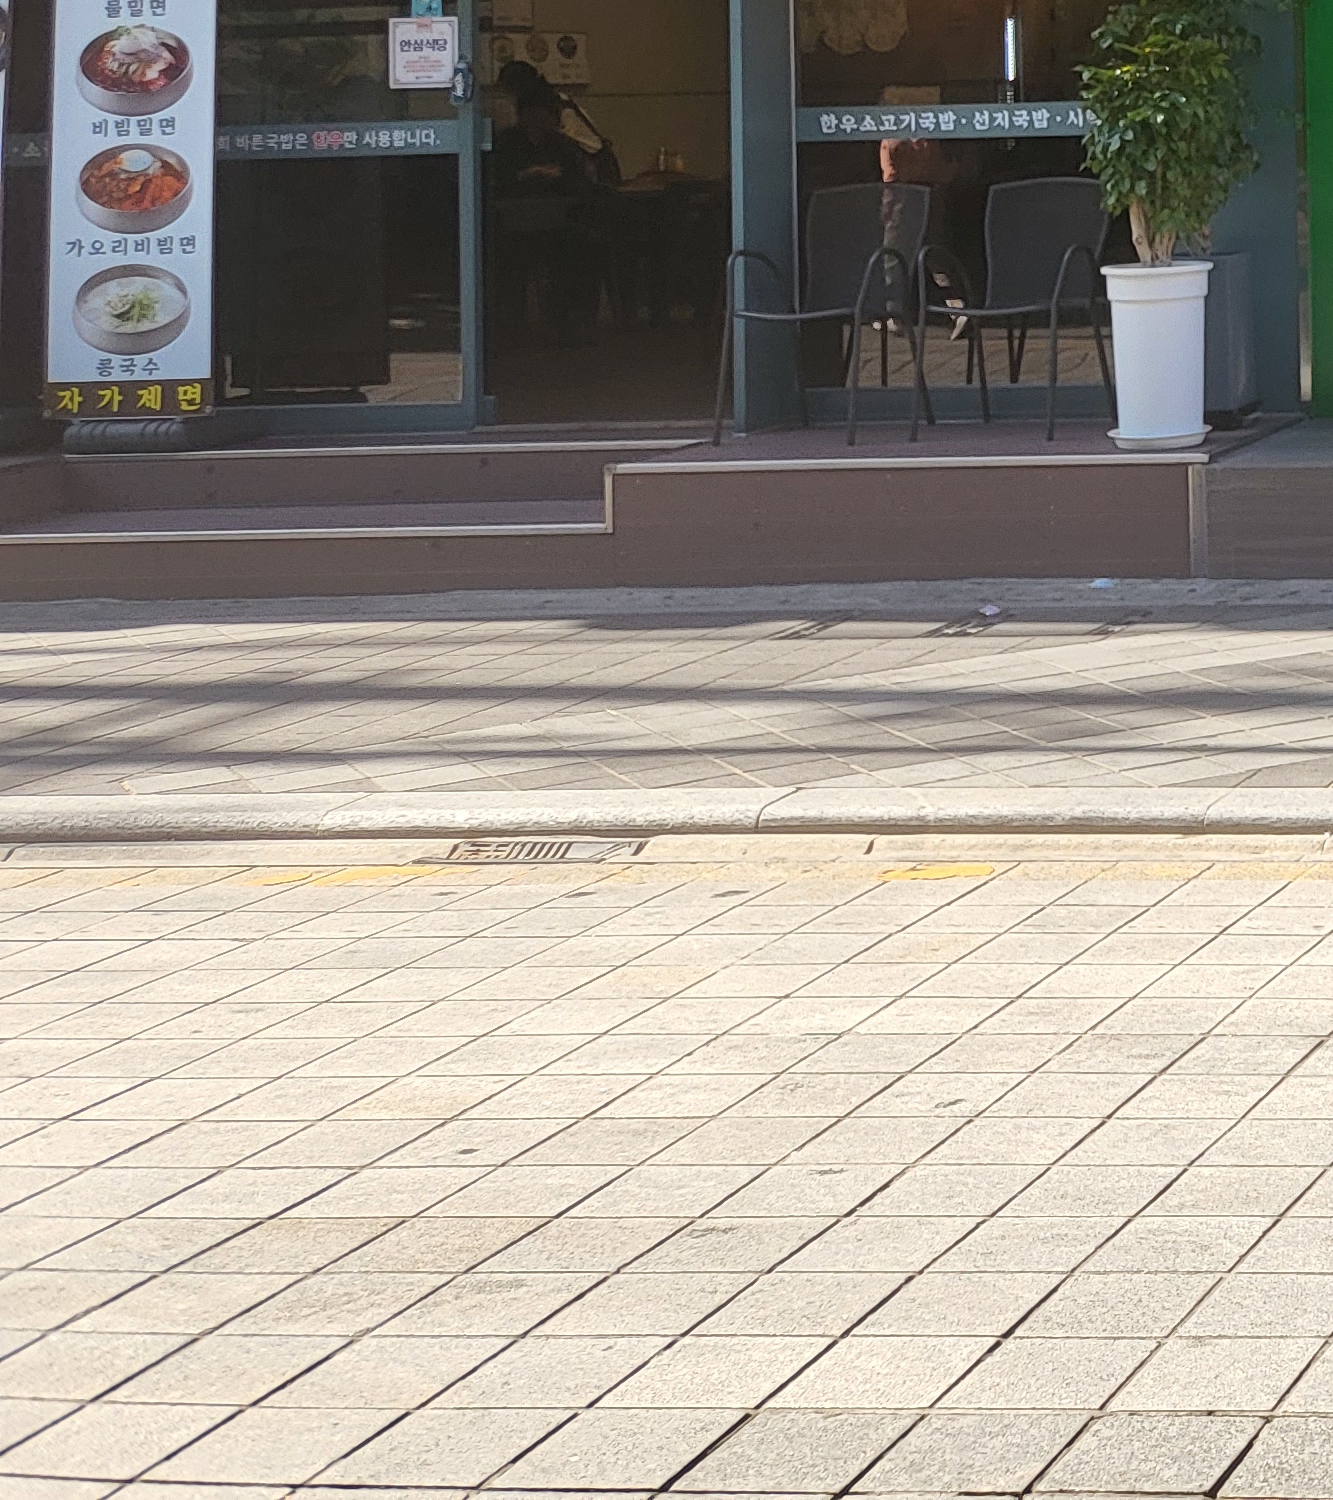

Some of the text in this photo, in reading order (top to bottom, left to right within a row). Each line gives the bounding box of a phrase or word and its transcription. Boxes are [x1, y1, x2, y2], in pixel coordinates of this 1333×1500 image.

[400, 38, 449, 53] 안심식당
[91, 115, 177, 137] 비빔밀면
[236, 132, 309, 152] 바른국밥은
[362, 128, 441, 148] 사용합니다.
[64, 234, 198, 258] 가오리비빔면
[95, 356, 161, 378] 콩국수
[56, 382, 205, 413] 자가제면
